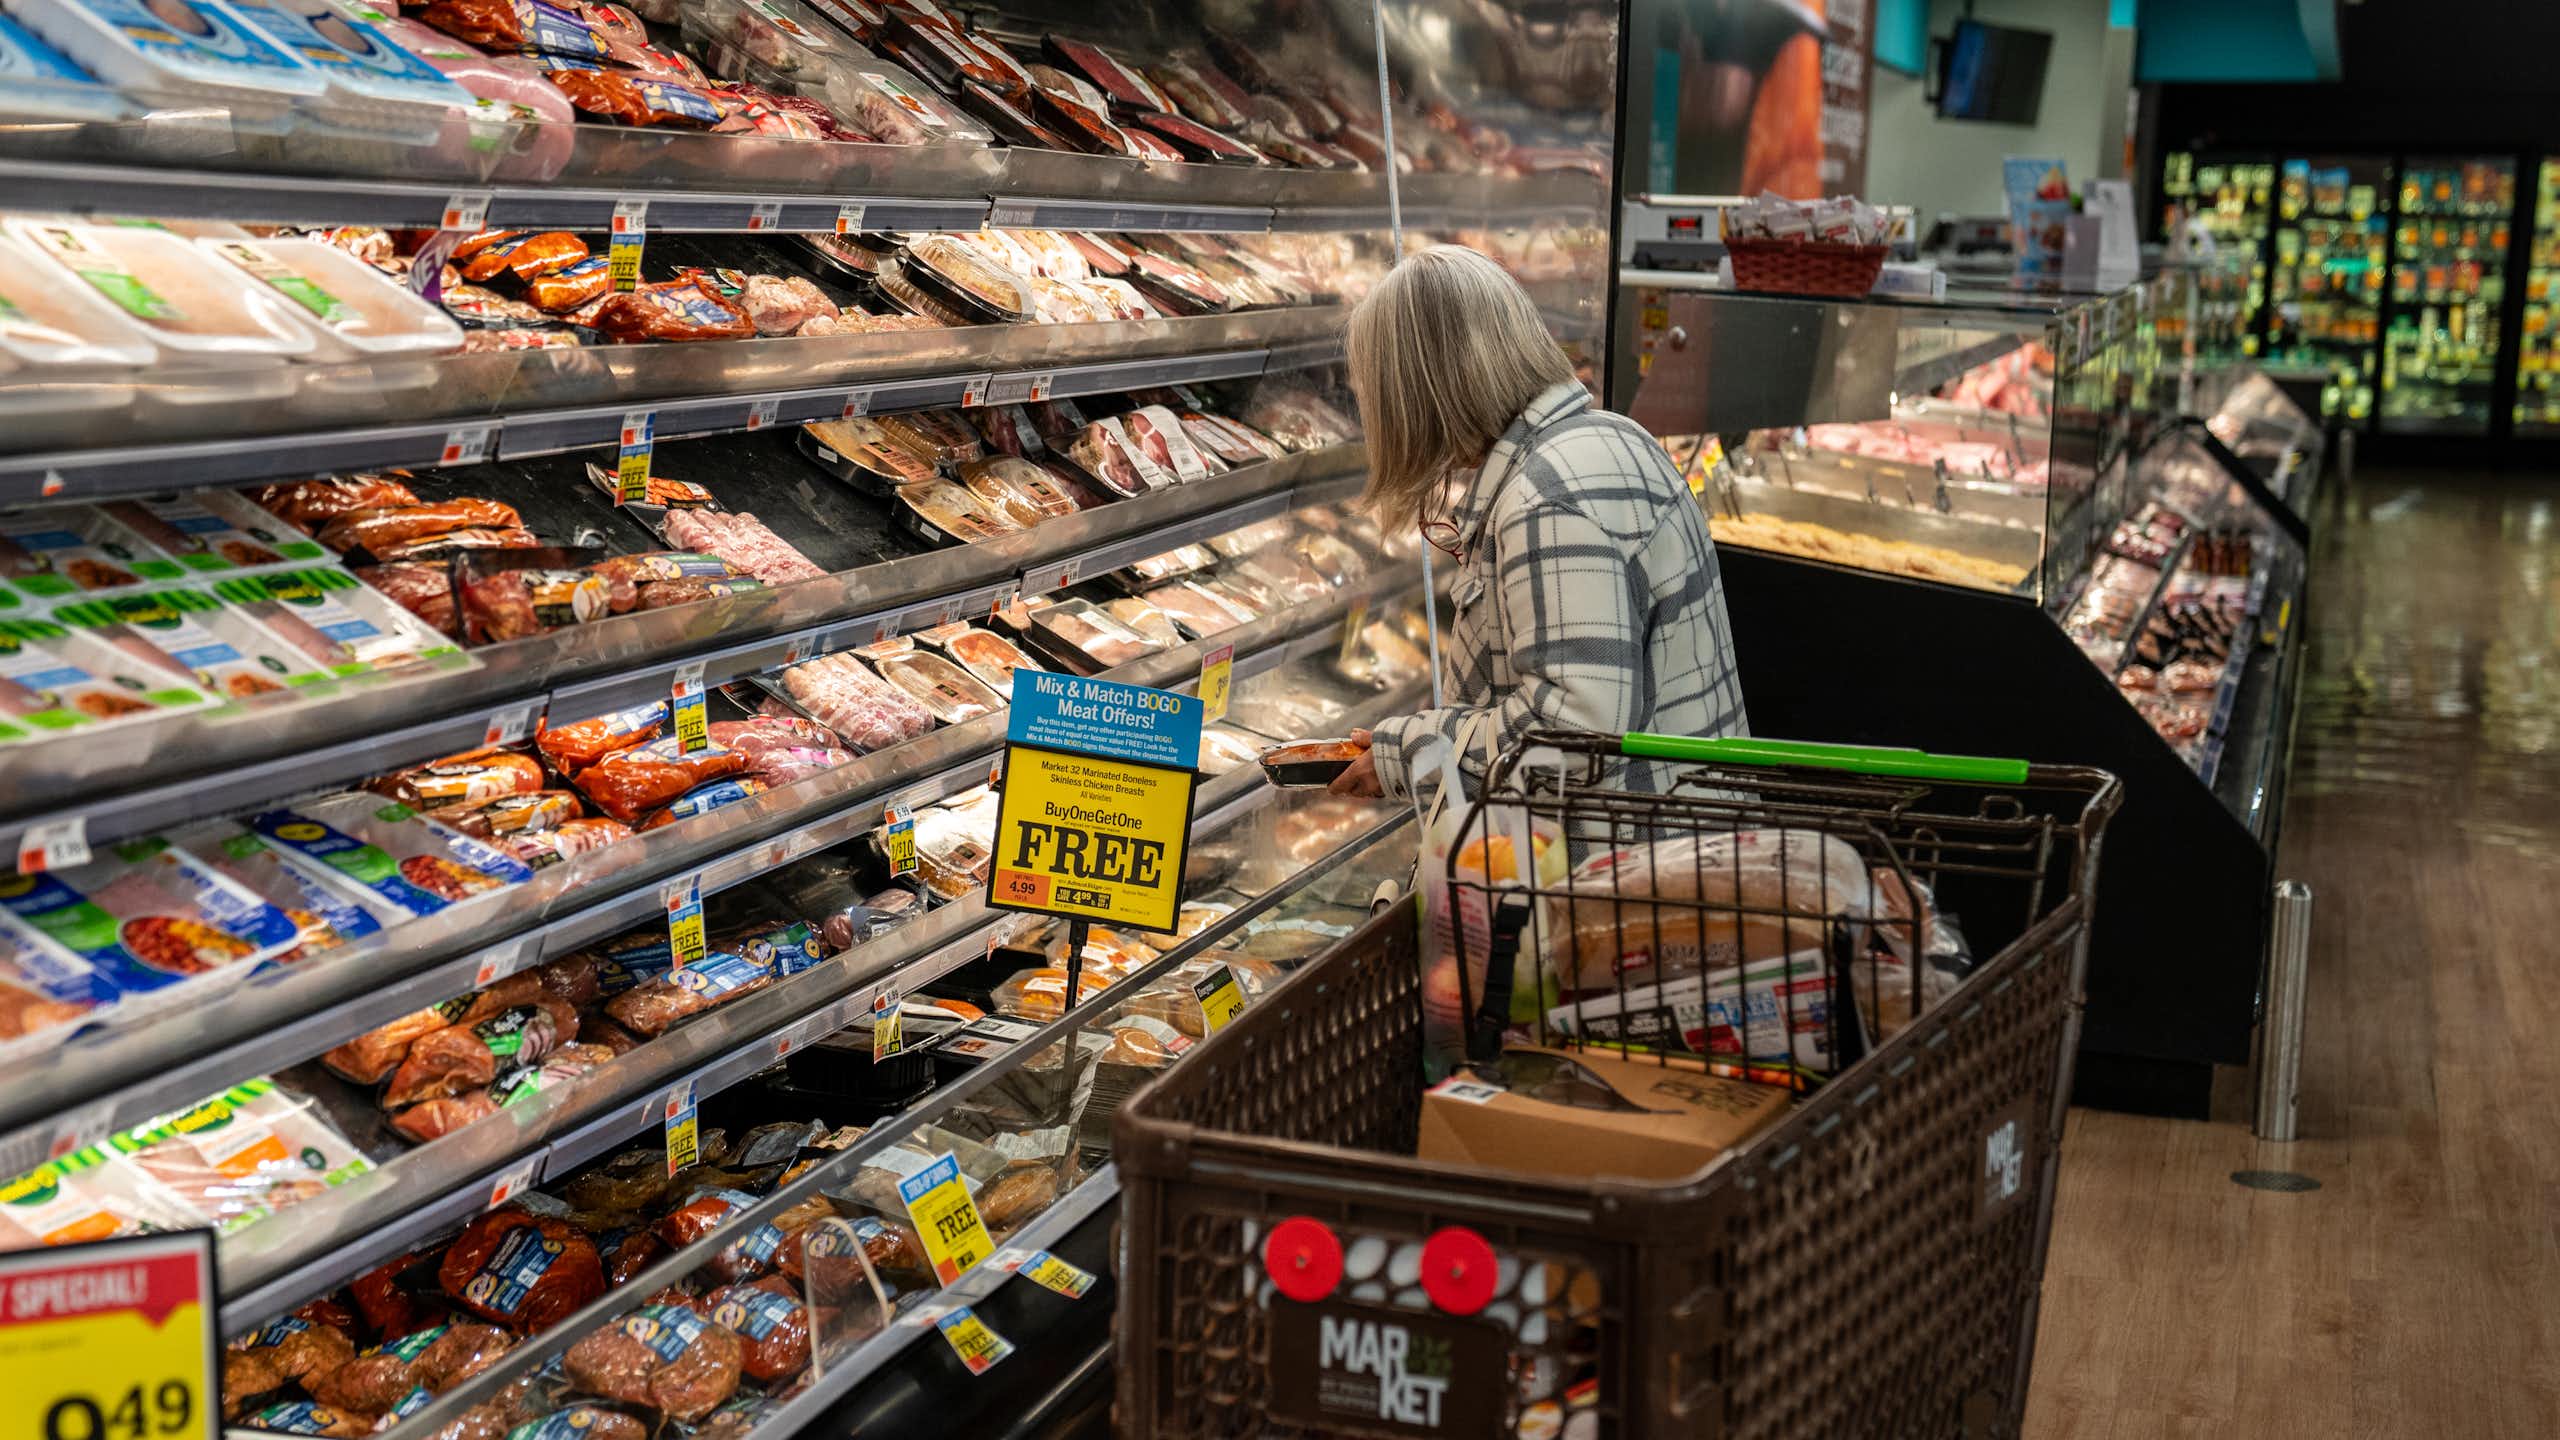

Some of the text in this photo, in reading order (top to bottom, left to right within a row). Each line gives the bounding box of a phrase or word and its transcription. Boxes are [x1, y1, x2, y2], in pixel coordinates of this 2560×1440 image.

[608, 262, 636, 277] FREE
[620, 471, 645, 487] FREE
[1036, 675, 1181, 715] Mix & Match BOGO
[1057, 698, 1156, 730] Meat Offers!
[678, 721, 703, 741] FREE
[1028, 724, 1044, 734] meat
[1044, 726, 1059, 736] item
[1059, 729, 1066, 737] of
[1066, 730, 1083, 741] equal
[1090, 733, 1108, 743] lesser
[1108, 736, 1125, 746] value
[1125, 738, 1143, 748] FREE!
[1143, 742, 1158, 751] Look
[1158, 743, 1168, 752] for
[1168, 744, 1179, 754] the
[1037, 715, 1173, 744] Buy this item, get any other participating BOGO
[1026, 732, 1179, 763] Mix & Match BOGO signs throughout the department.
[1041, 760, 1157, 788] Market 32 Marinated Boneless
[1050, 773, 1145, 797] Skinless Chicken Breasts
[1080, 790, 1112, 804] All Varieties
[1045, 801, 1143, 830] BuyOneGetOne
[1012, 820, 1165, 889] FREE
[1009, 880, 1036, 895] 4.99
[674, 932, 700, 954] FREE
[670, 1135, 693, 1159] FREE
[1985, 1120, 2015, 1178] MAR
[936, 1202, 978, 1245] FREE
[10, 1264, 149, 1319] SPECIAL!
[959, 1331, 993, 1359] FREE
[1320, 1315, 1409, 1377] MAR
[1379, 1374, 1448, 1428] KET
